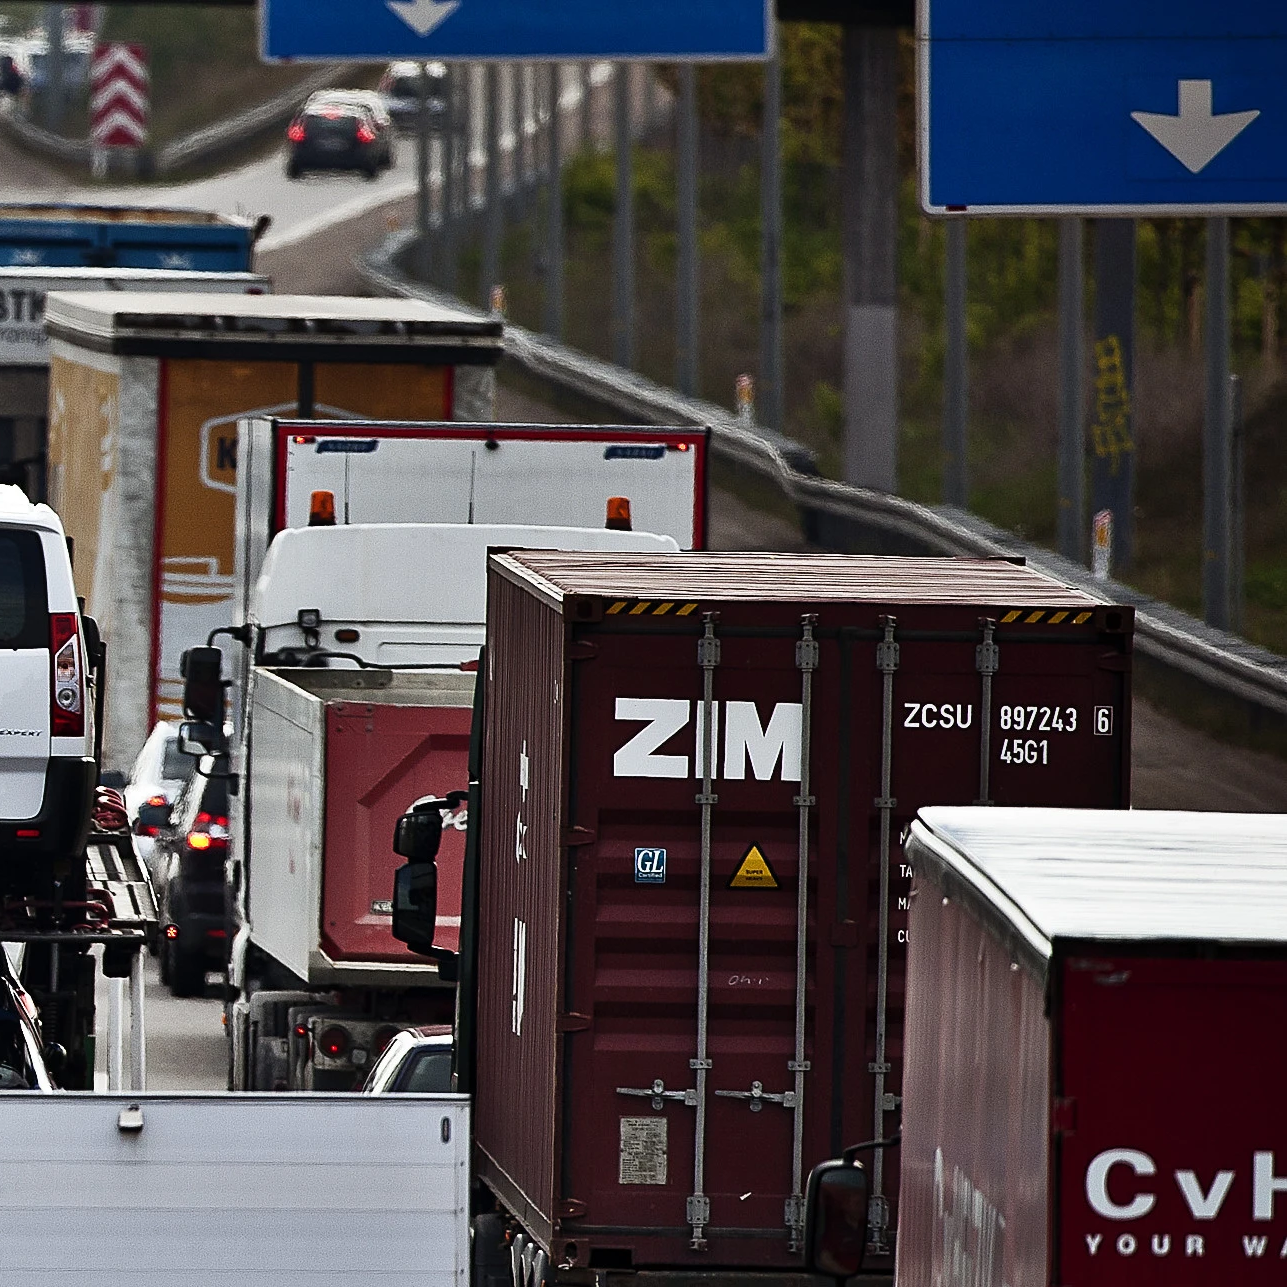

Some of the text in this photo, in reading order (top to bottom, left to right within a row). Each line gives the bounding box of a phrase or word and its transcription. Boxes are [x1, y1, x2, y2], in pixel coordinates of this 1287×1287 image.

[903, 703, 1110, 733] ZCSU 897243 6
[614, 697, 803, 781] ZIM
[1000, 738, 1048, 765] 45G1
[637, 850, 664, 873] GL
[639, 871, 663, 879] Certified
[1084, 1233, 1205, 1257] YOUR
